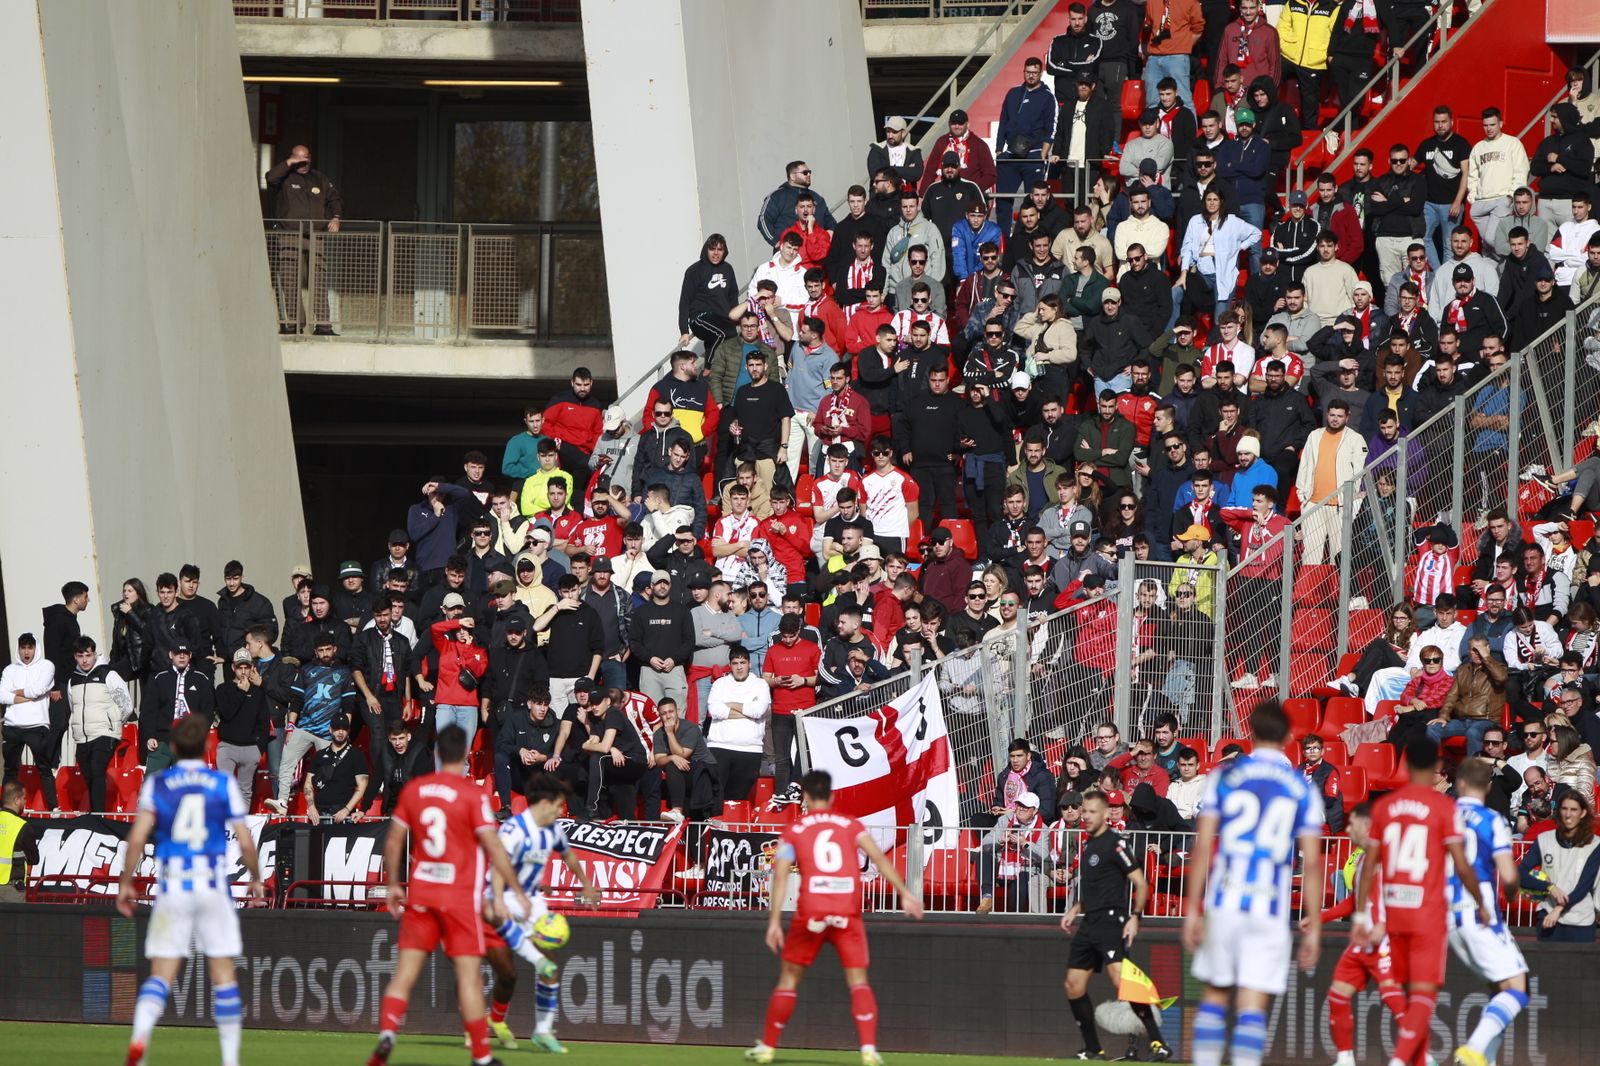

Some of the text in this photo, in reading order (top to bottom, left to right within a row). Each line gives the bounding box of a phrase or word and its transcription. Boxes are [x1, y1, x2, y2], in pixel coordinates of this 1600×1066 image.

[834, 725, 870, 768] G
[171, 792, 209, 852] 4
[420, 806, 447, 858] 3
[569, 823, 664, 857] RESPECT
[1222, 789, 1299, 864] 24
[707, 836, 752, 878] APC
[814, 828, 843, 873] 6
[1383, 822, 1430, 882] 14
[549, 858, 648, 899] FANS!
[553, 929, 724, 1044] aLiga
